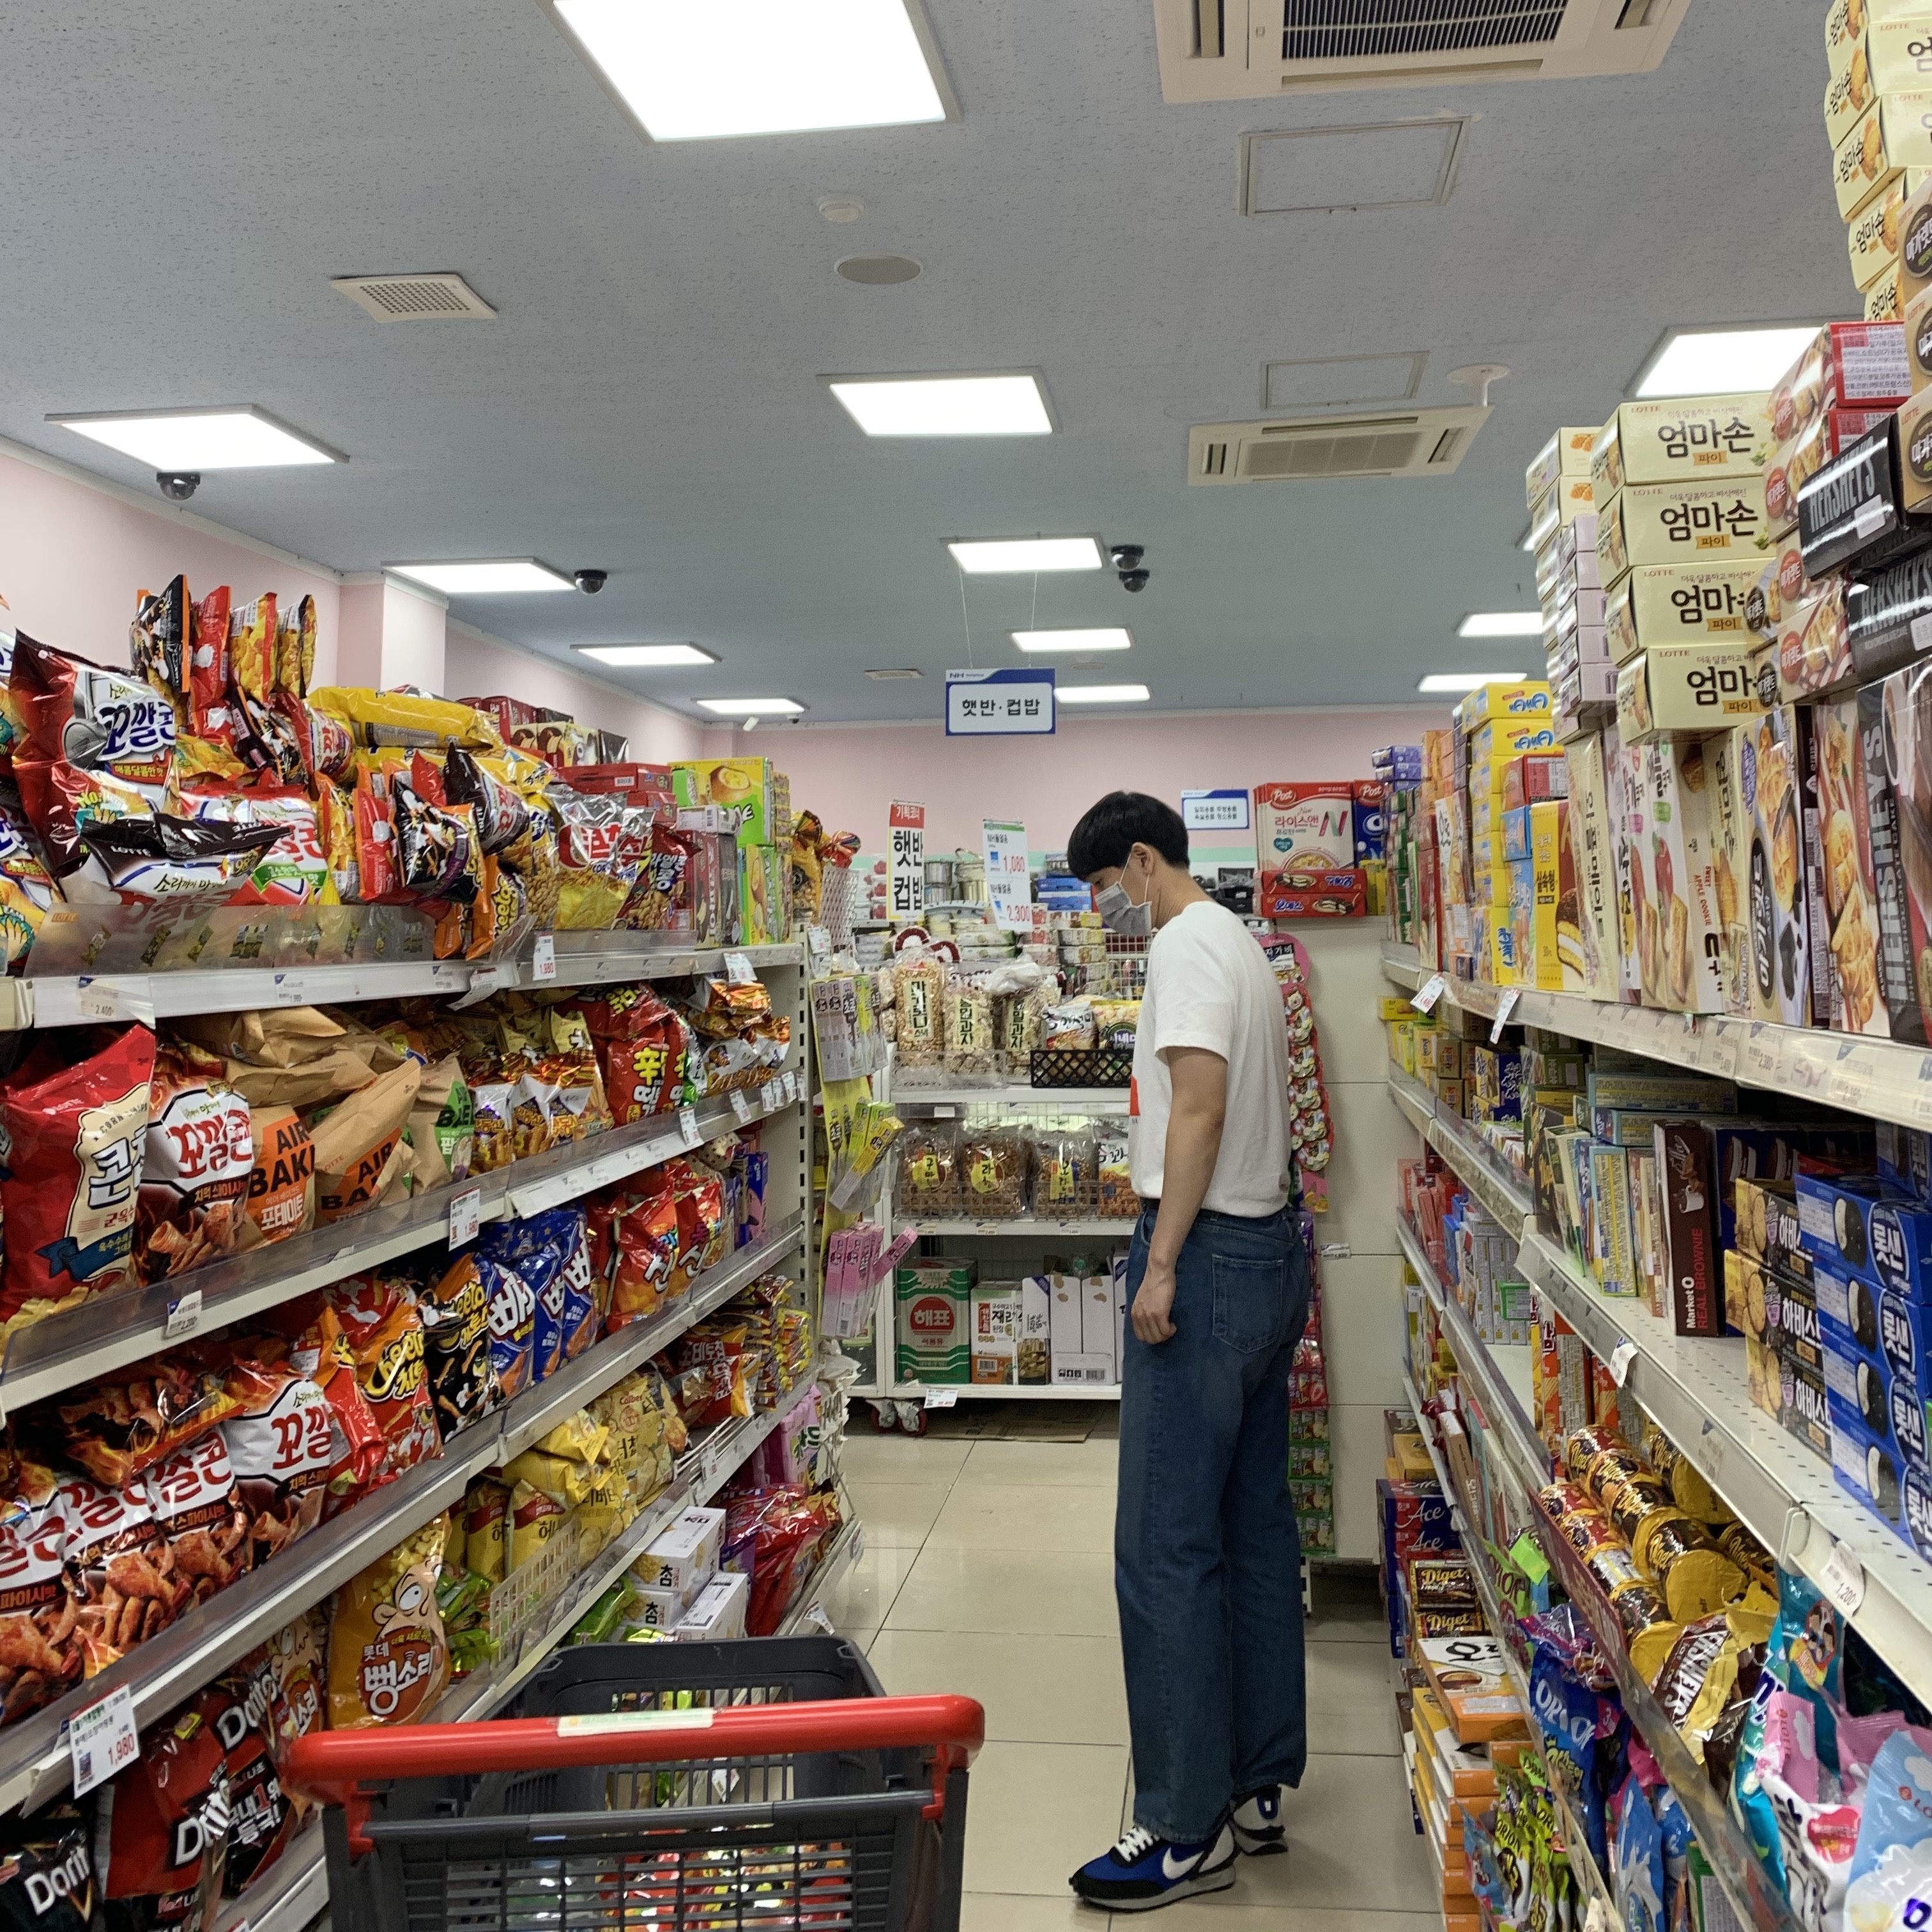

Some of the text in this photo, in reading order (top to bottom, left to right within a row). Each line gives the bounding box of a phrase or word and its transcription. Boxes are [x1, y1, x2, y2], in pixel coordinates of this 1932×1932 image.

[1830, 69, 1852, 115] 엄마손
[1894, 94, 1924, 102] LOTTE
[1839, 137, 1864, 183] 엄마손
[1856, 210, 1885, 254] 엄마손
[1659, 418, 1754, 457] 엄마손
[1697, 452, 1723, 464] 파이
[1660, 500, 1758, 542] 엄마손
[1700, 536, 1726, 548] 파이
[1711, 618, 1738, 630] 파이
[1728, 700, 1754, 712] 파이
[1273, 790, 1294, 800] Post
[1361, 786, 1384, 797] Post
[1275, 816, 1319, 829] 라이스앤
[1889, 798, 1899, 845] CAKE
[110, 845, 151, 857] LOTTE
[893, 830, 923, 868] 햇반
[1863, 726, 1907, 1001] HERSHEY'S
[893, 875, 923, 911] 컵밥
[1694, 874, 1711, 926] APPLE COOKIE
[1894, 850, 1912, 956] CHOCOLATE
[52, 912, 77, 922] LOTTE
[1006, 905, 1030, 922] 2,300
[100, 1113, 124, 1134] CORN
[275, 1121, 310, 1155] AIR
[166, 1109, 253, 1179] 꼬깔콘
[358, 1141, 392, 1185] AIR
[1873, 1222, 1904, 1272] 롯샌
[1692, 1227, 1708, 1330] REAL BROWNIE
[489, 1278, 535, 1337] 빠새
[914, 1309, 951, 1327] 해표
[1687, 1289, 1696, 1329] Market
[1882, 1308, 1913, 1360] 롯샌
[395, 1359, 425, 1398] 치토
[272, 1405, 331, 1468] 꼬깔
[1892, 1395, 1922, 1455] 롯샌
[1395, 1501, 1446, 1528] Ace
[1406, 1530, 1445, 1552] Ace
[661, 1565, 673, 1587] 참
[1421, 1567, 1466, 1584] Diget
[645, 1602, 658, 1625] 참
[1426, 1613, 1470, 1631] Diget
[362, 1641, 389, 1662] 롯데
[362, 1652, 434, 1716] 뻥소리
[1535, 1678, 1596, 1751] ORION
[107, 1733, 135, 1767] 1,980
